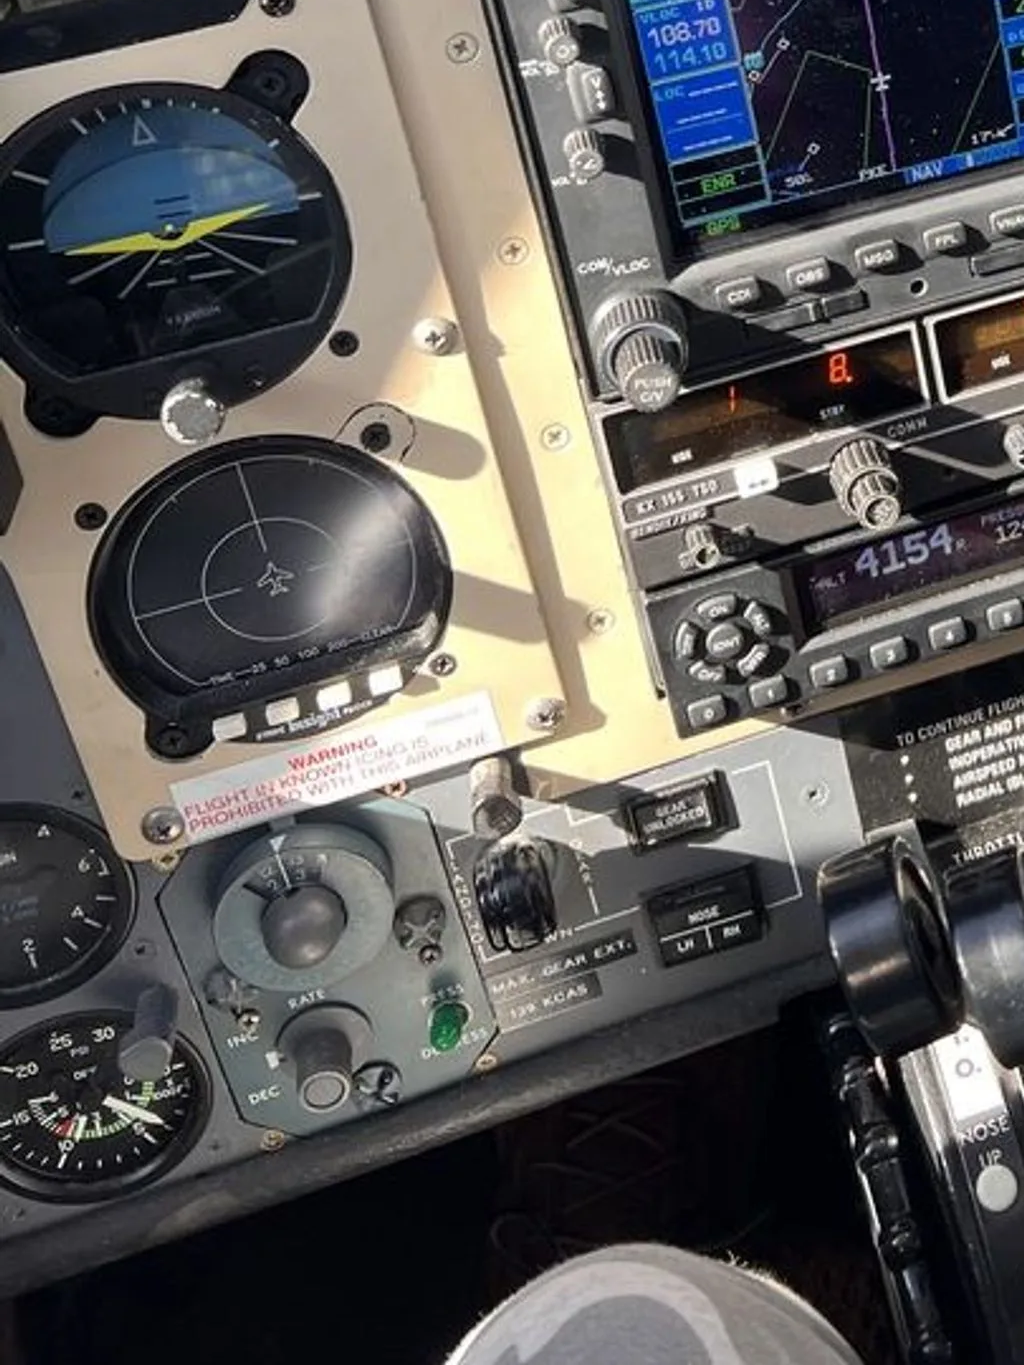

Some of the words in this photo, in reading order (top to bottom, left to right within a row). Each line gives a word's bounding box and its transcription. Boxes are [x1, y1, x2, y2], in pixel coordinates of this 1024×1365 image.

[649, 17, 720, 47] 108.70
[912, 161, 943, 182] NAV
[702, 175, 736, 193] ENR
[854, 523, 952, 578] 4154
[897, 732, 914, 747] TO
[918, 708, 985, 740] CONTINUE
[945, 732, 981, 752] GEAR
[984, 718, 1013, 736] AND
[289, 736, 378, 771] WARNING
[183, 790, 249, 818] FLIGHT
[256, 781, 275, 798] IN
[276, 762, 350, 794] KNOWN
[355, 742, 409, 768] ICING
[953, 757, 1015, 789] AIRSPEED
[188, 789, 302, 833] PROHIBITED
[308, 773, 353, 797] WITH
[360, 756, 400, 779] THIS
[955, 781, 1004, 808] RADIAL
[688, 905, 720, 923] NOSE
[542, 954, 587, 976] GEAR
[288, 989, 326, 1009] RATE
[50, 1032, 72, 1051] 25
[92, 1026, 115, 1042] 30
[227, 1031, 259, 1049] INC
[15, 1061, 39, 1078] 20
[248, 1087, 281, 1105] DEC
[960, 1109, 1011, 1145] NOSE
[979, 1149, 1003, 1166] UP
